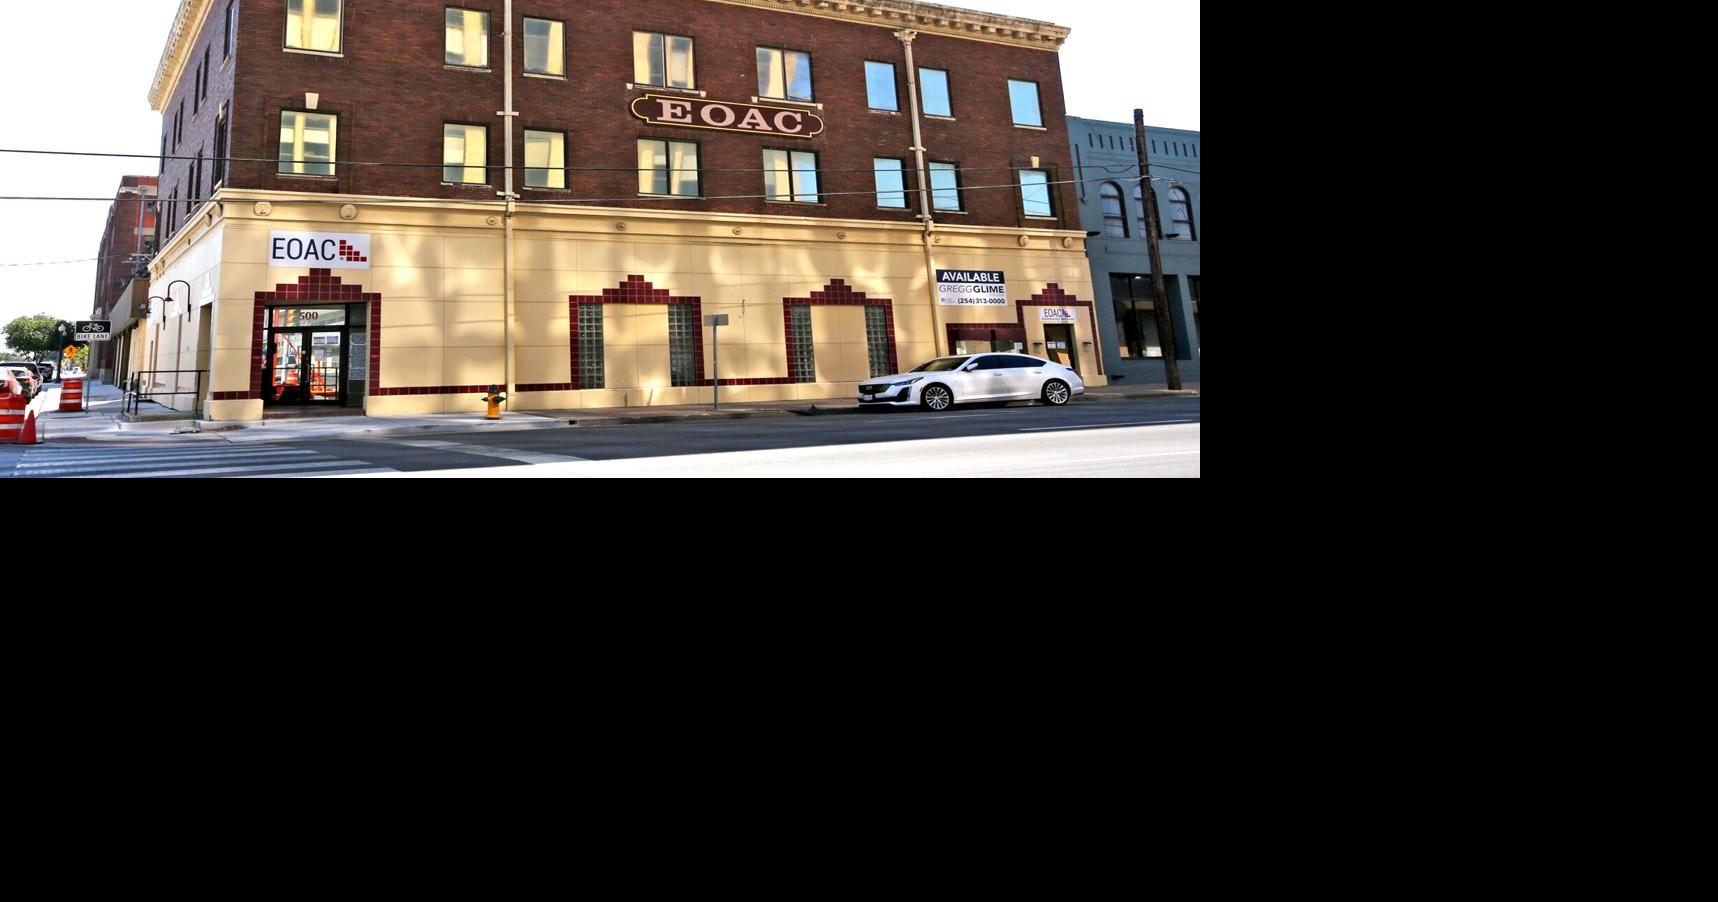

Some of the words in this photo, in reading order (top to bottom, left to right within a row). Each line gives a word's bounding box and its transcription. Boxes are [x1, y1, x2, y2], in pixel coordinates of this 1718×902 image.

[656, 99, 802, 133] EOAC
[272, 238, 336, 261] EOAC
[942, 272, 1000, 282] AVAILABLE
[300, 312, 318, 320] 500
[1043, 308, 1062, 317] EOAC
